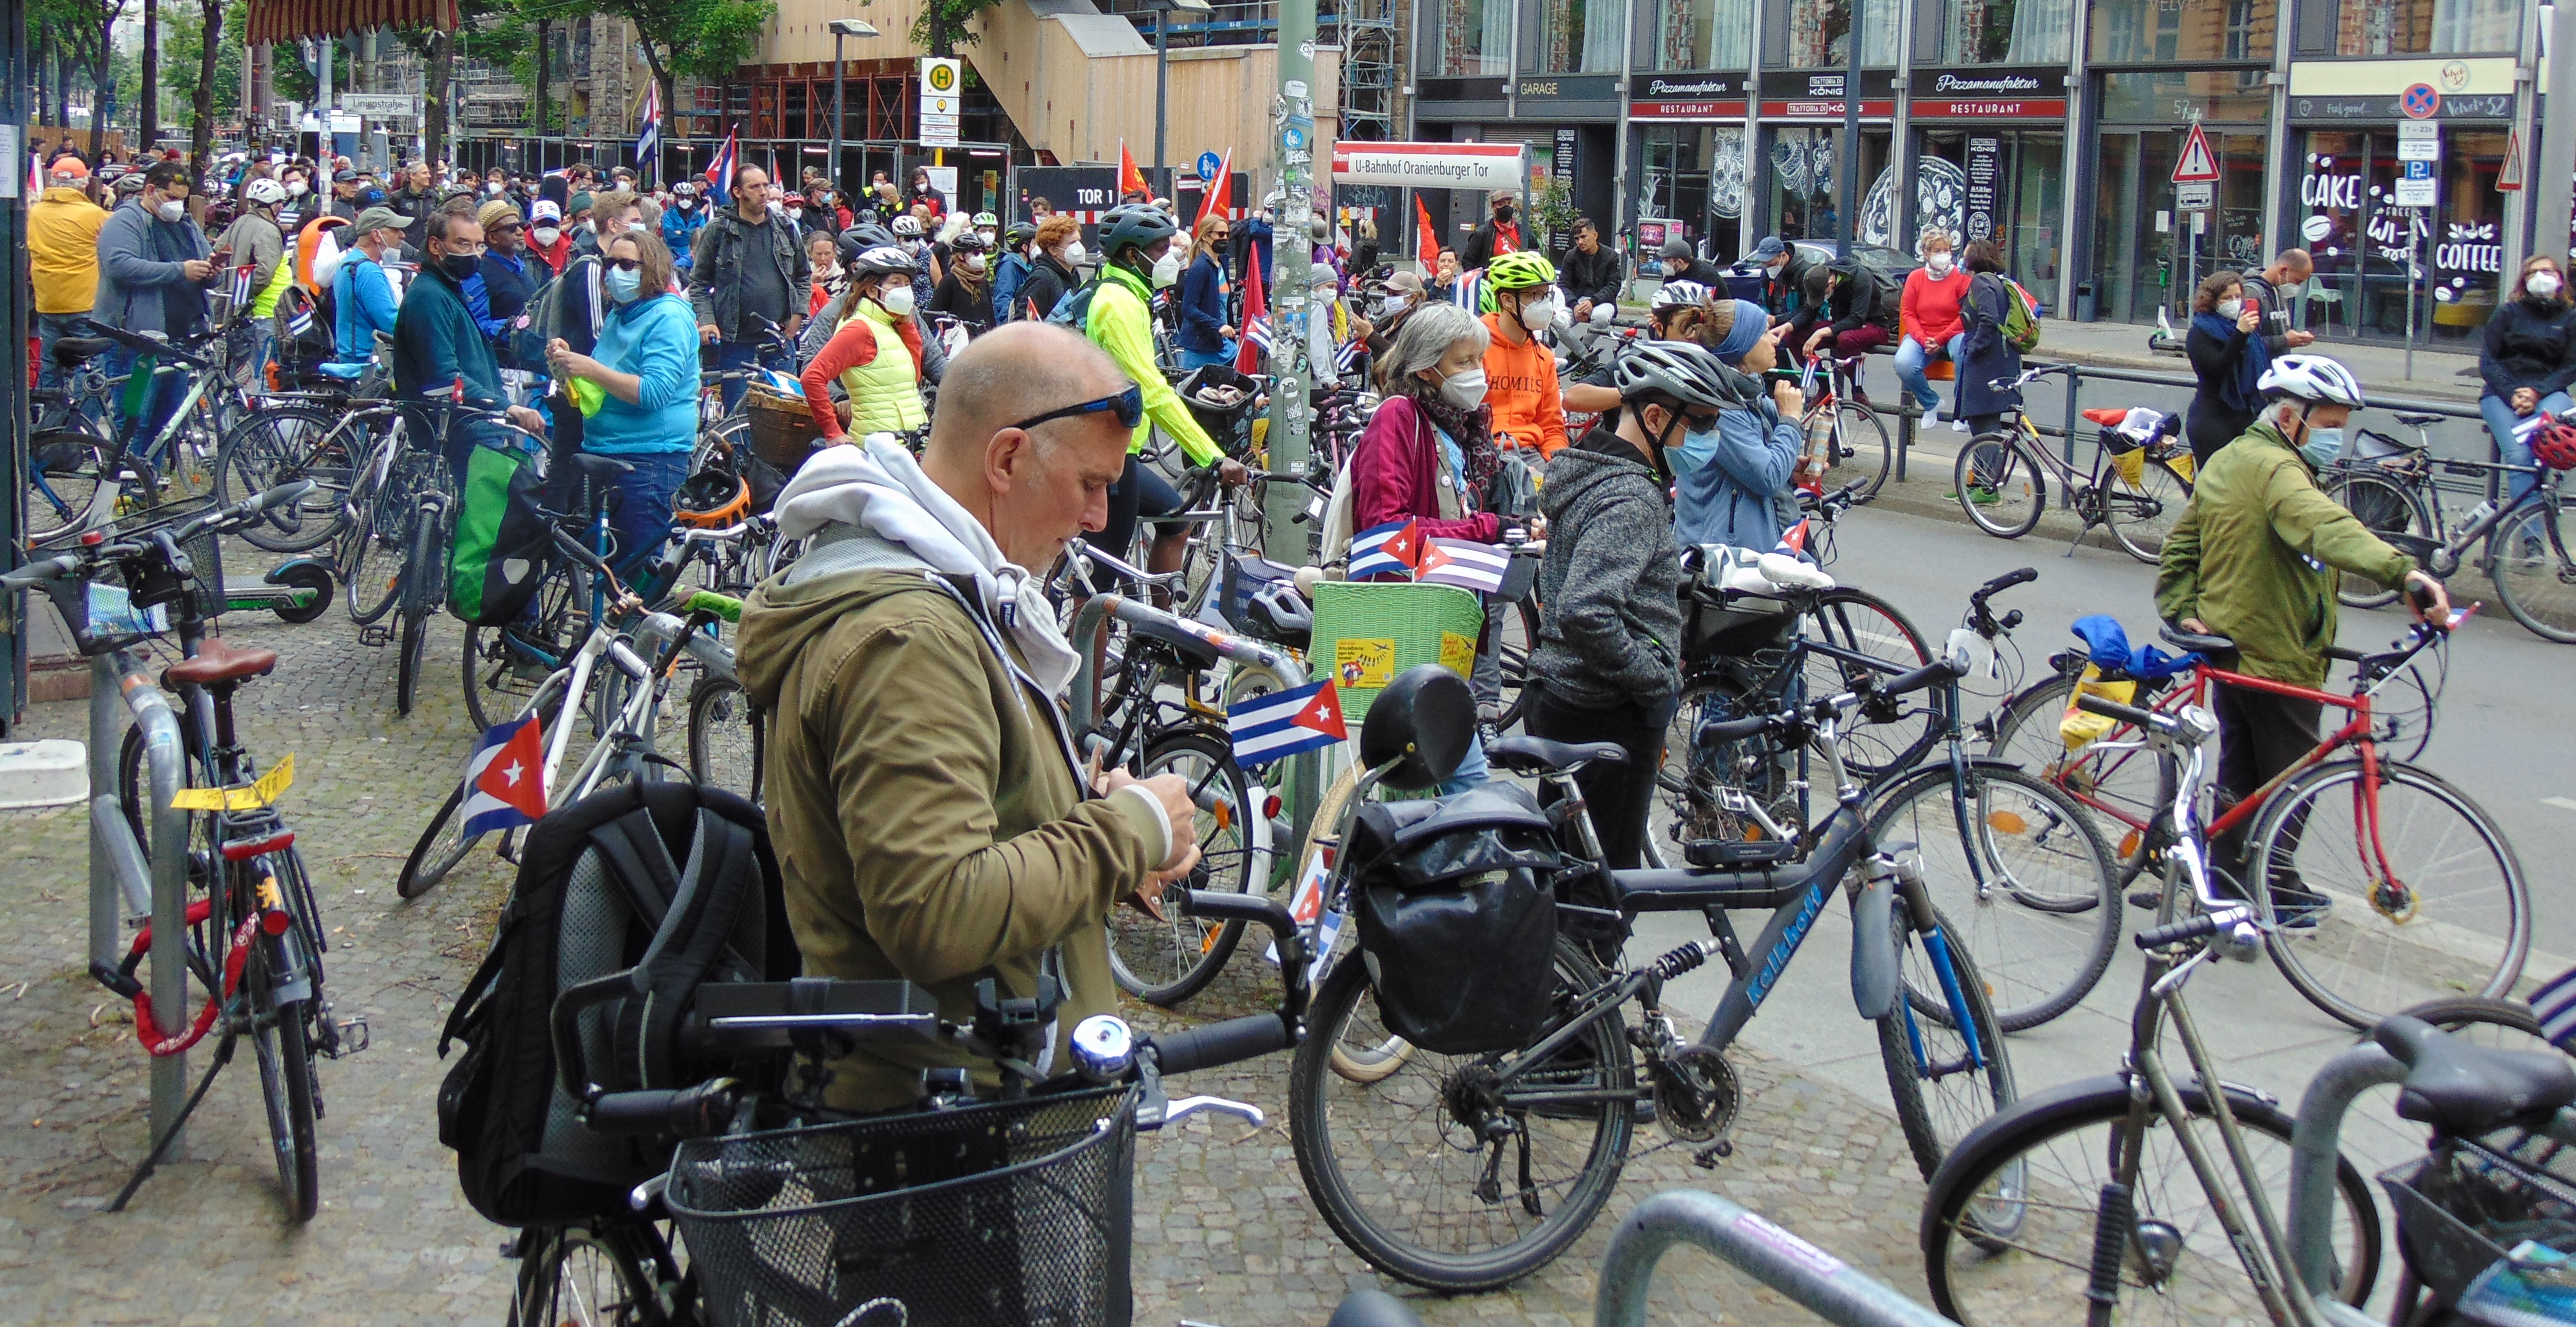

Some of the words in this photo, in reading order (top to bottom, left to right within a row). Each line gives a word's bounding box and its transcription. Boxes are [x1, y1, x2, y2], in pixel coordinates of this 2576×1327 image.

[937, 70, 948, 85] H
[1936, 75, 2039, 93] Pizzamanufaktur
[1521, 83, 1557, 95] GARAGE
[1650, 80, 1726, 95] Pizzamanufaktur
[1809, 87, 1843, 95] KÖNIG
[353, 99, 402, 109] Linienstraße
[1661, 105, 1713, 113] RESTAURANT
[1951, 104, 2020, 113] RESTAURANT
[2485, 97, 2506, 116] 52
[1334, 151, 1348, 162] Tram
[1356, 159, 1402, 174] U-Bahnhof
[1404, 161, 1471, 180] Oranienburger
[1474, 163, 1489, 177] Tor
[2411, 162, 2424, 177] P
[1077, 189, 1102, 204] TOR
[1108, 190, 1112, 203] 1
[2302, 175, 2361, 209] CAKE
[2386, 208, 2410, 217] FREE
[2367, 216, 2428, 243] WI-I
[2436, 243, 2501, 272] COFFEE
[1647, 364, 1687, 388] CRATONI
